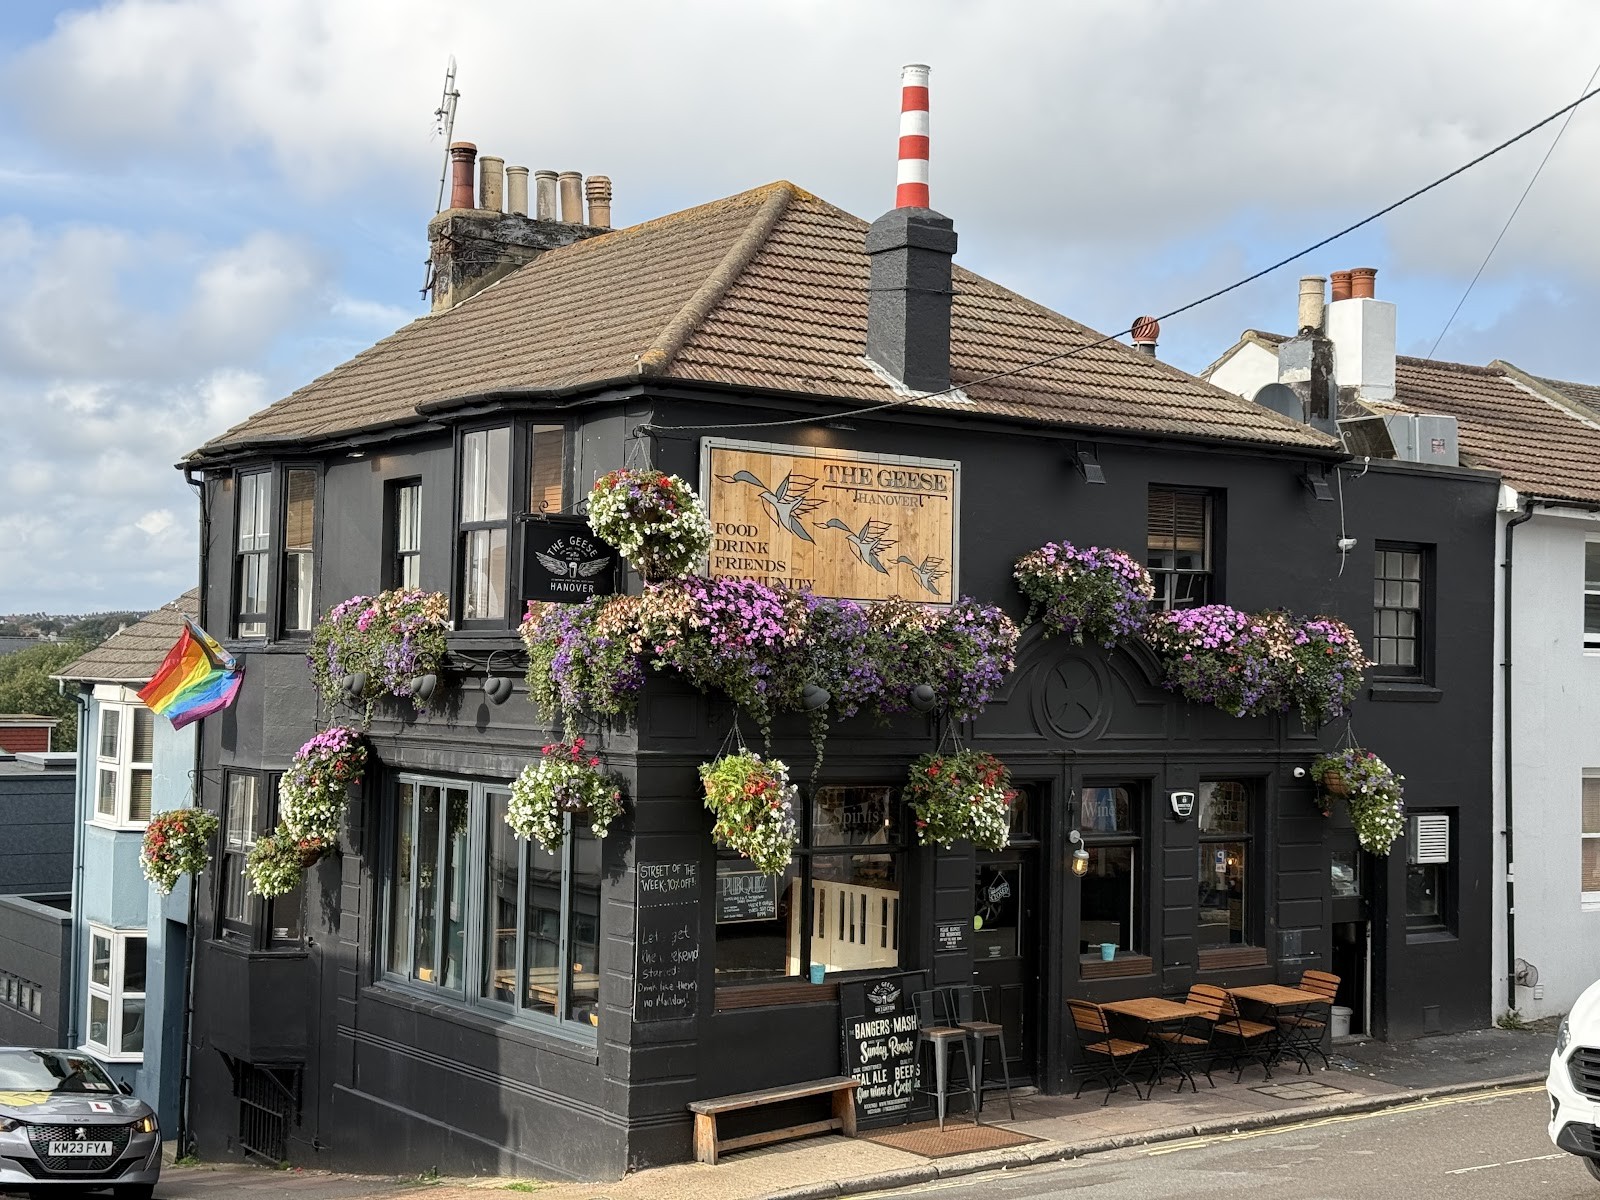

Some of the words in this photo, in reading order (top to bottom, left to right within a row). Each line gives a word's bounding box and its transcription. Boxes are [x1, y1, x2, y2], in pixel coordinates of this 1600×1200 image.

[823, 464, 873, 486] THE
[877, 469, 947, 492] GEESE
[857, 492, 919, 507] HANOVER
[715, 522, 758, 537] FOOD
[547, 539, 565, 556] THE
[569, 536, 598, 558] GEESE
[715, 538, 769, 554] DRINK
[714, 557, 786, 572] FRIENDS
[550, 582, 594, 593] HANOVER
[833, 807, 879, 828] Spirits
[640, 864, 670, 878] STREET
[672, 864, 681, 874] OF
[684, 863, 696, 876] THE
[872, 985, 880, 994] THE
[881, 981, 895, 991] GEESE
[854, 1019, 890, 1039] BANGERS
[893, 1014, 917, 1033] MASH
[860, 1041, 889, 1063] Sunday
[888, 1036, 914, 1058] Roasts
[873, 1069, 888, 1084] ALE
[887, 1084, 893, 1096] &
[54, 1143, 84, 1154] KM23
[86, 1143, 107, 1154] FYA
